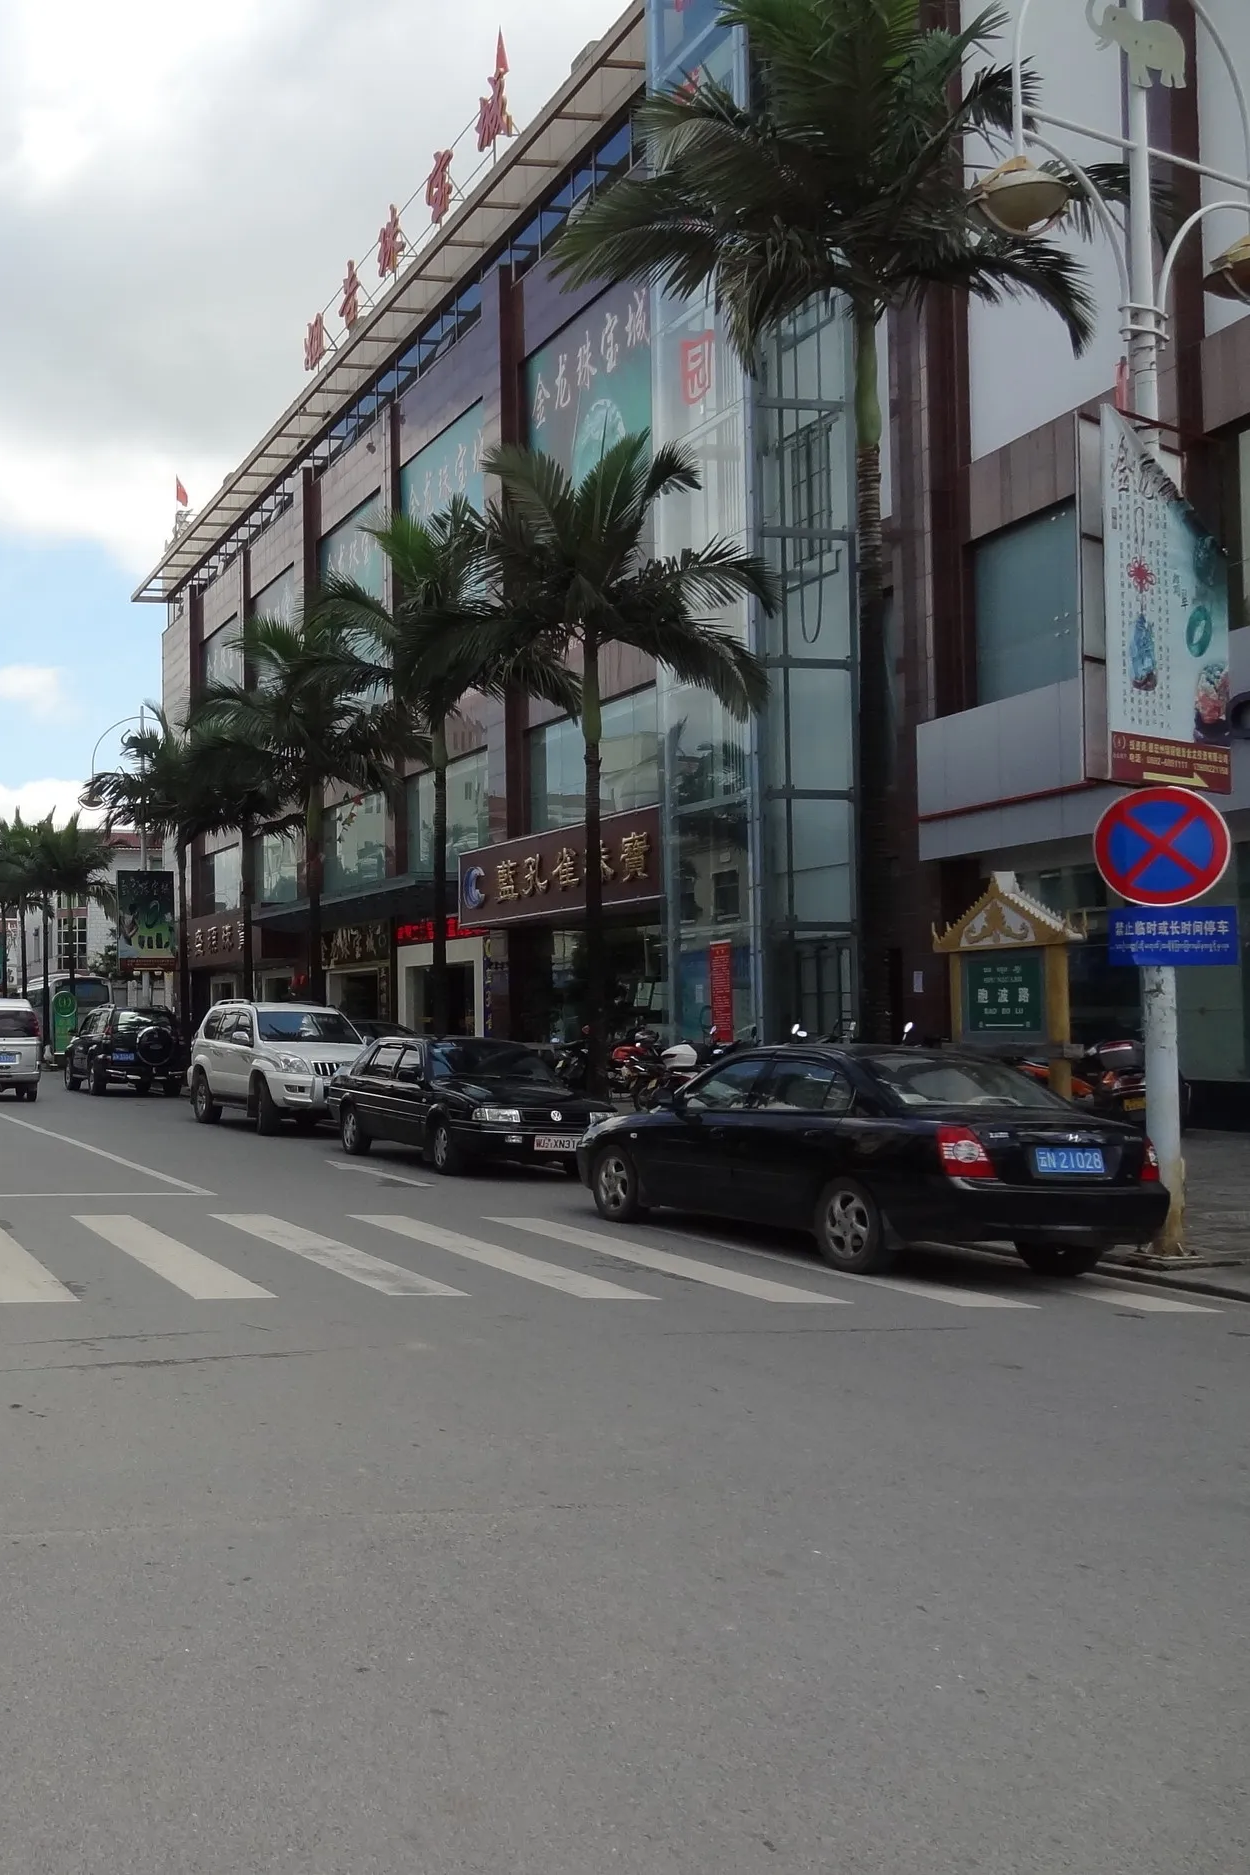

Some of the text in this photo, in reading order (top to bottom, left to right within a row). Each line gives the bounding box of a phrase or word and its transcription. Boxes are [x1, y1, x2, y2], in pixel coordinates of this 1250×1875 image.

[532, 287, 650, 430] 金龙珠宝城
[1114, 919, 1230, 936] 禁止临时或长时间停车
[977, 987, 1030, 1004] 胞波路
[1059, 1151, 1102, 1169] 21028
